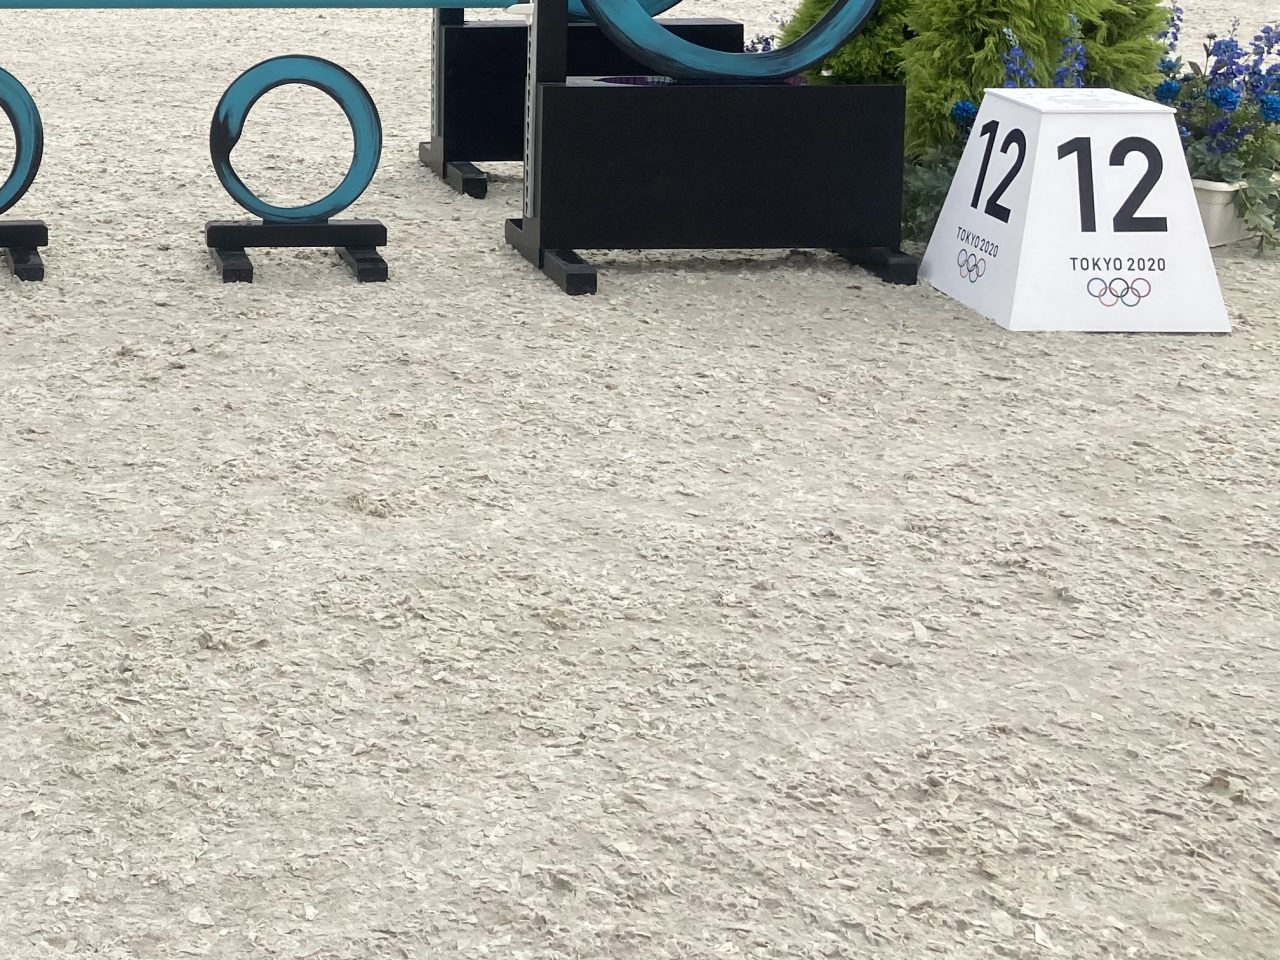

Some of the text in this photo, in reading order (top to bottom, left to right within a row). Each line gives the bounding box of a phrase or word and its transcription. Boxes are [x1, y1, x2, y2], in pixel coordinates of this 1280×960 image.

[970, 119, 1026, 224] 12
[1057, 136, 1168, 233] 12
[957, 226, 999, 258] TOKYO 2020
[1070, 257, 1166, 272] TOKYO 2020
